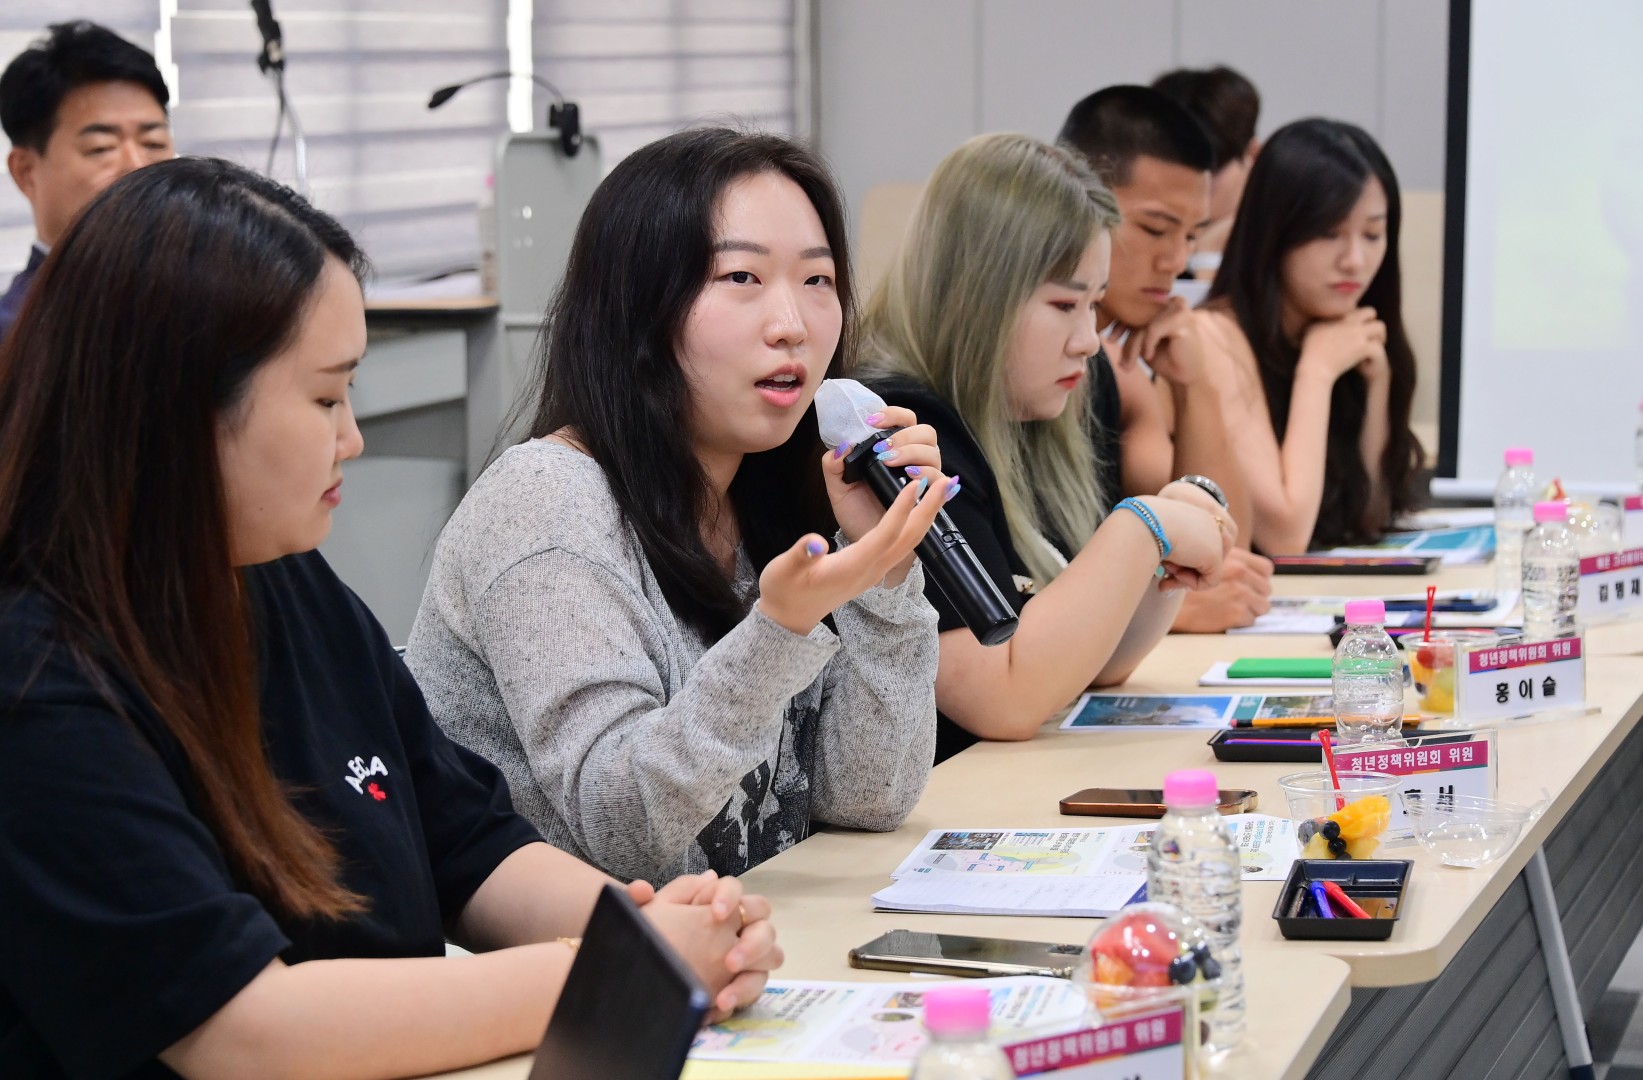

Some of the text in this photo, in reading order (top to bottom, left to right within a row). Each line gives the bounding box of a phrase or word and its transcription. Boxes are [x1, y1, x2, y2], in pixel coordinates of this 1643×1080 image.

[1479, 641, 1572, 668] 청년정책위원회 위원
[1351, 745, 1474, 772] 청년정책위원회 위원
[1013, 1017, 1167, 1073] 청년정책위원회 위원
